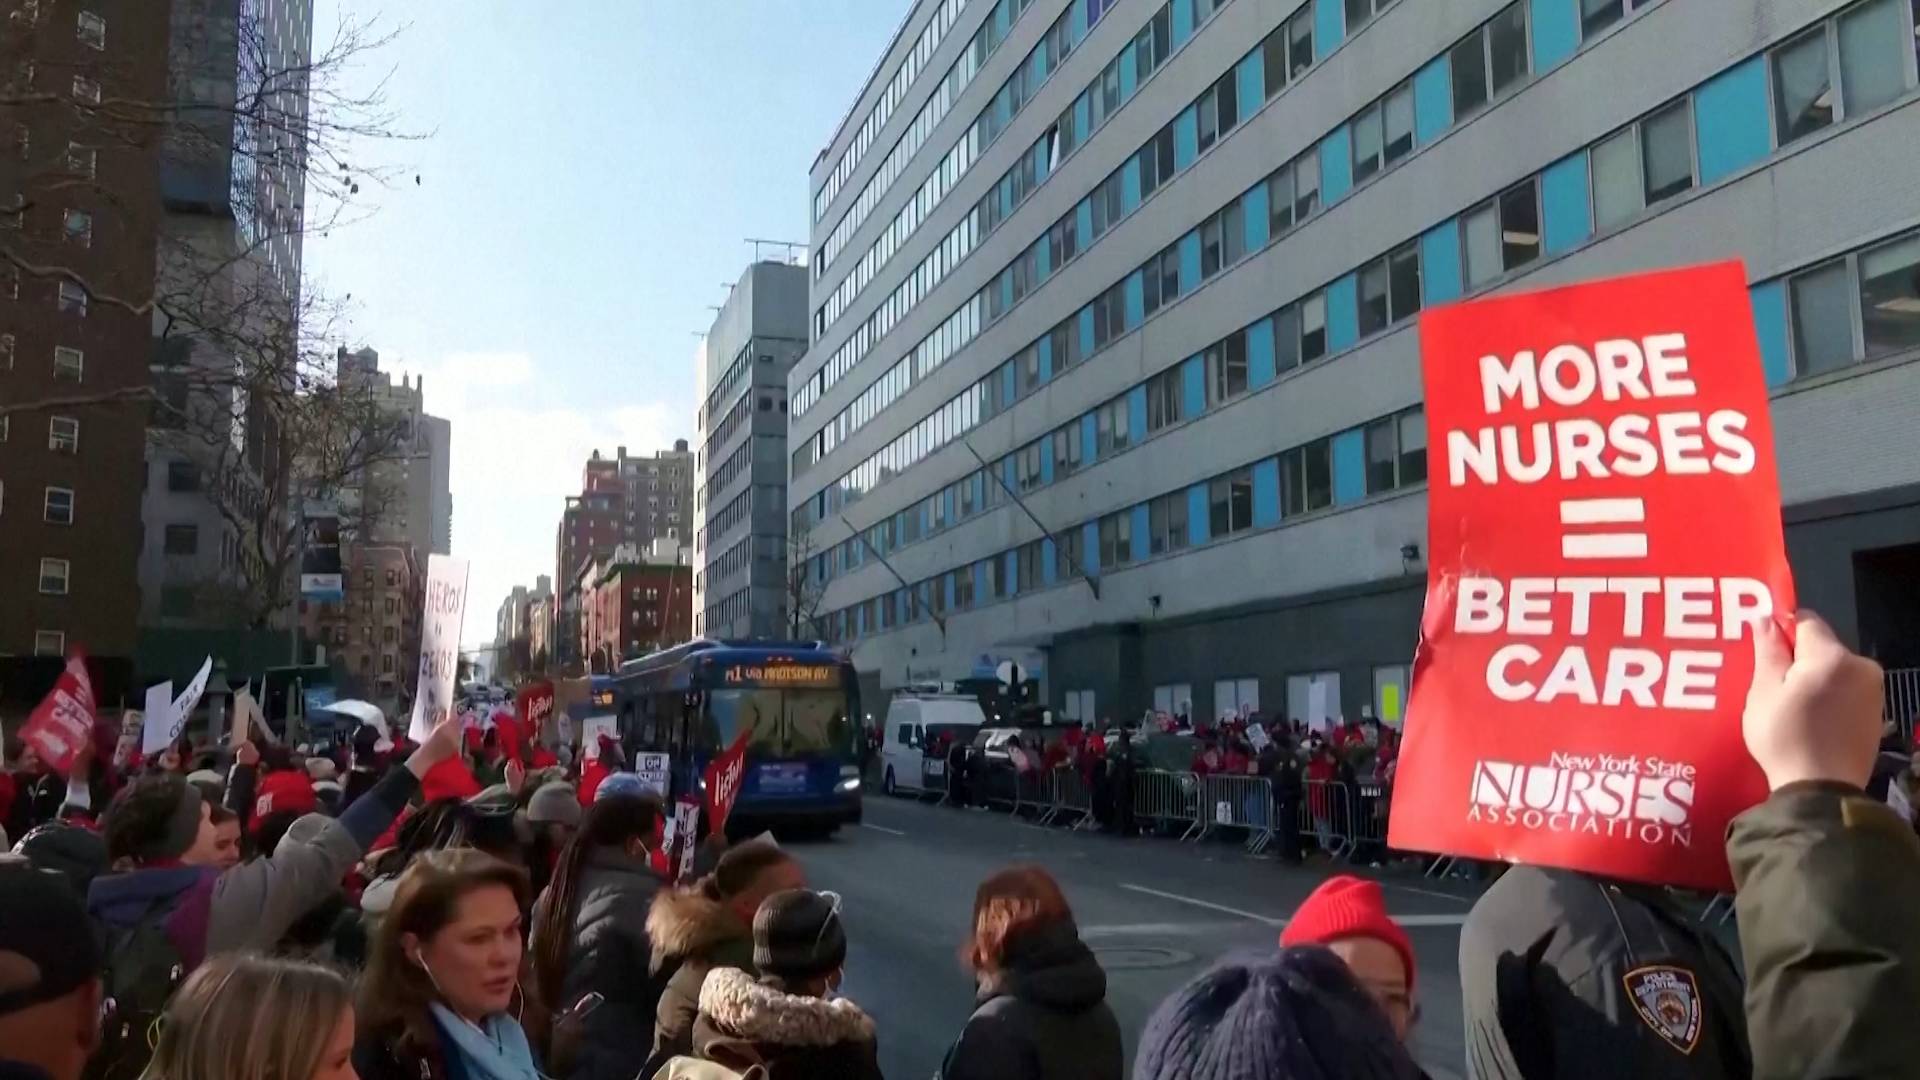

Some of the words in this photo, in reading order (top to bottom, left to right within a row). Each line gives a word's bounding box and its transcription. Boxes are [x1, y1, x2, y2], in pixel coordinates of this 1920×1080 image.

[1479, 333, 1696, 414] MORE
[1447, 410, 1756, 487] NURSES
[1455, 577, 1773, 640] BETTER
[1486, 644, 1723, 710] CARE
[1470, 760, 1696, 826] NURSES
[1550, 752, 1596, 770] New
[1598, 753, 1641, 774] York
[1645, 757, 1697, 781] State
[1467, 803, 1693, 847] ASSOCIATION
